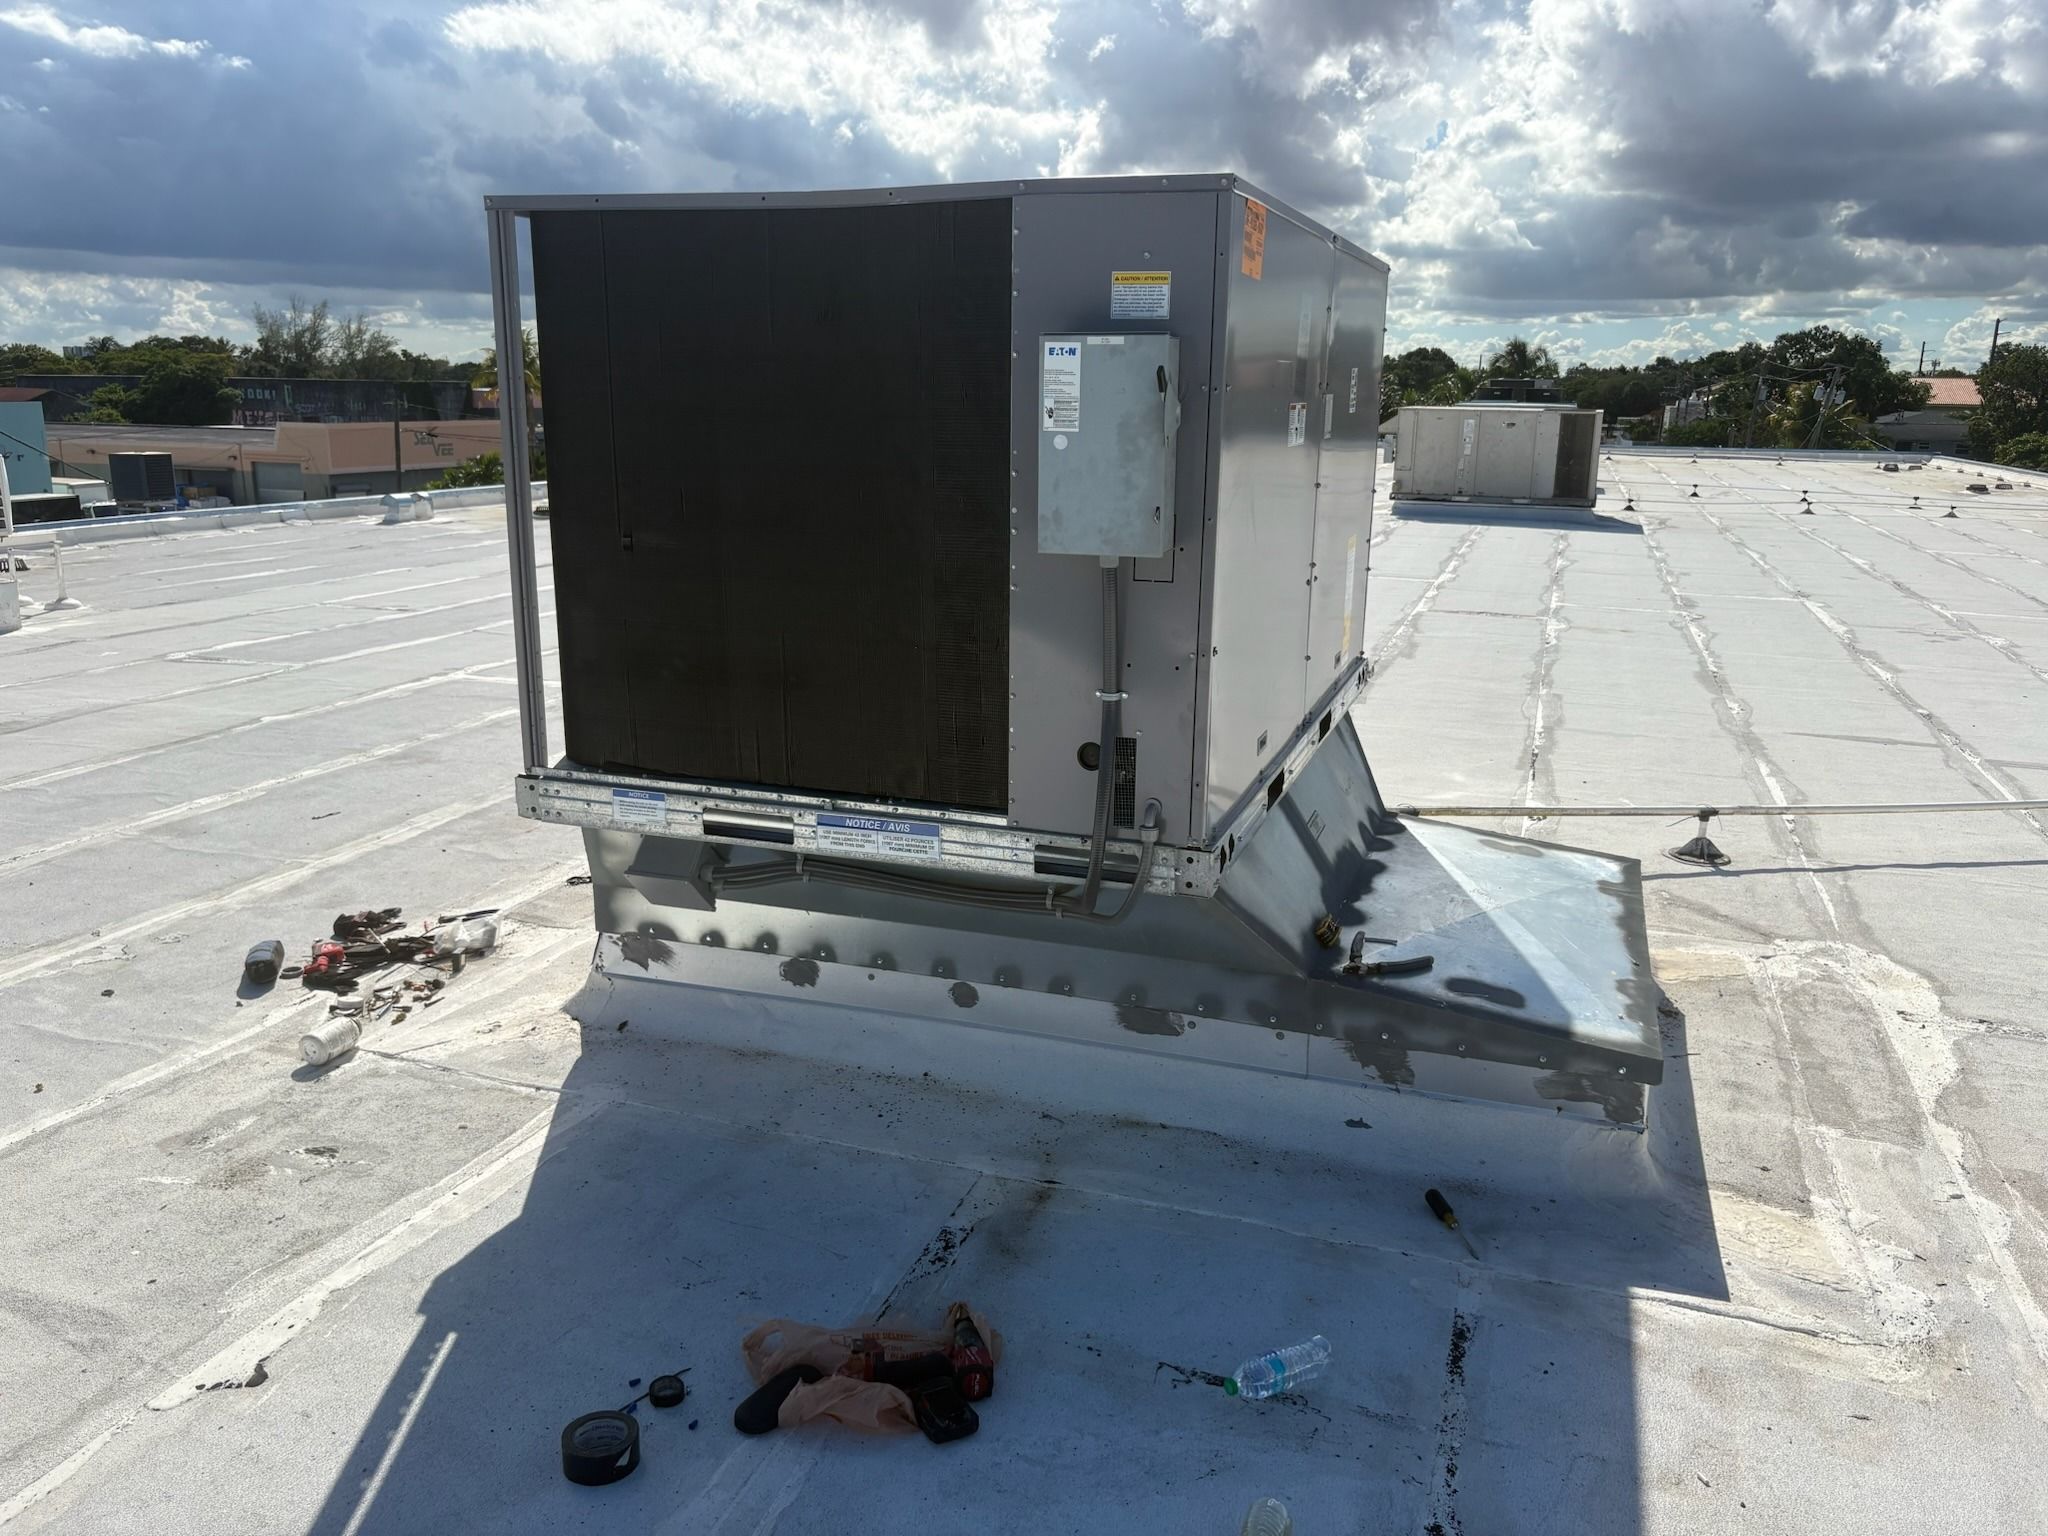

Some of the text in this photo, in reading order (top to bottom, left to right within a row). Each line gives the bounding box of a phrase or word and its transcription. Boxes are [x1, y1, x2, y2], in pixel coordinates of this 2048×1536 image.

[845, 818, 911, 832] NOTICE / AVIS
